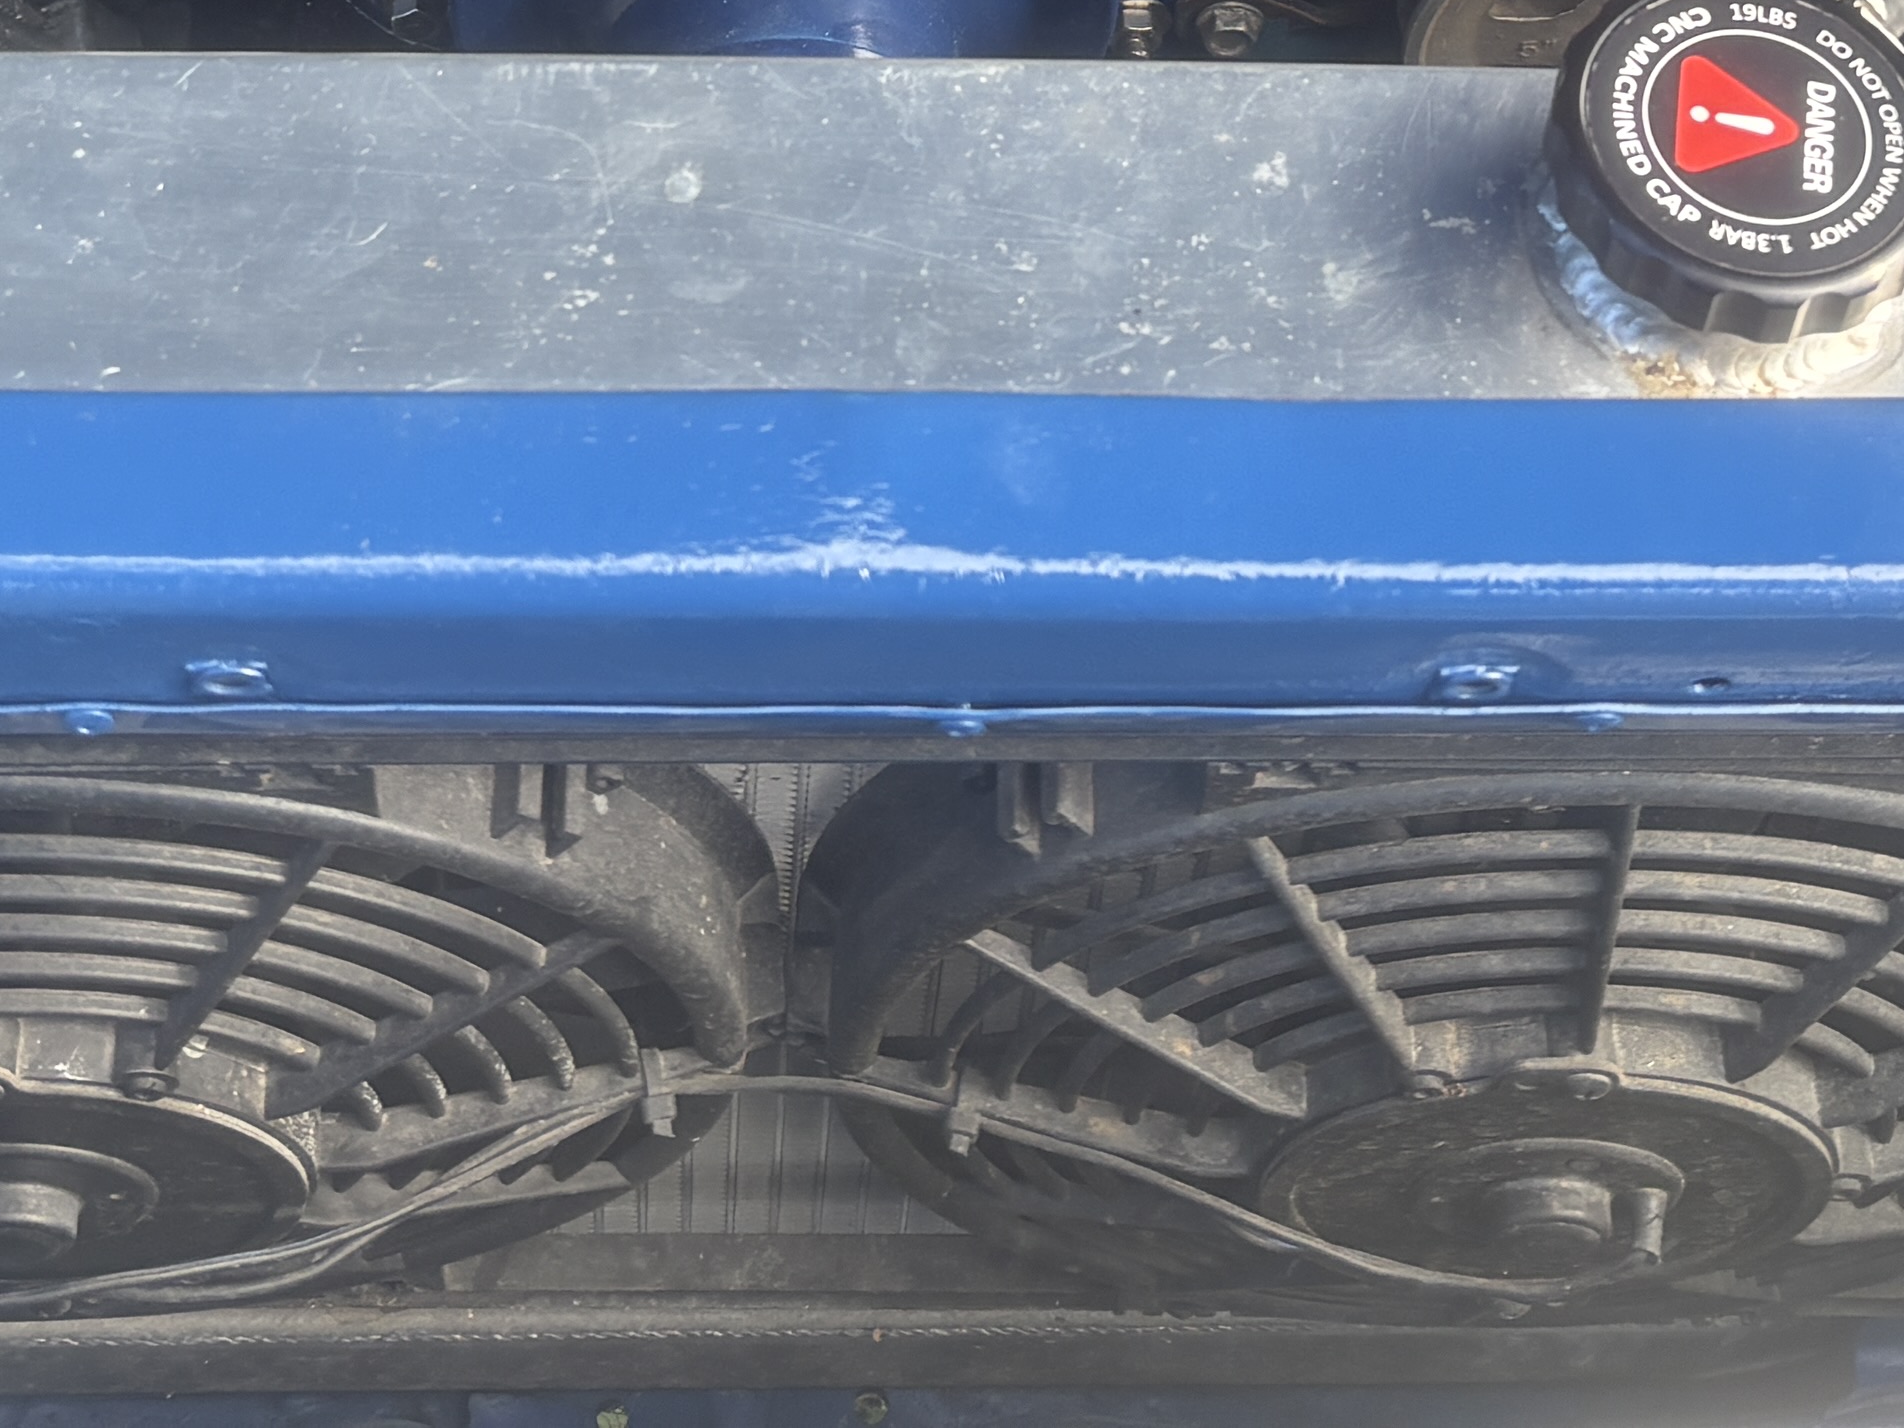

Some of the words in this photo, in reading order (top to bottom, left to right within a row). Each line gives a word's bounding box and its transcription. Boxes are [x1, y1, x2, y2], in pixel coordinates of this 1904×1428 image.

[1657, 6, 1712, 44] CNC
[1729, 3, 1797, 30] 19LBS
[1815, 29, 1853, 61] DO
[1848, 57, 1893, 101] NOT
[1611, 40, 1660, 177] MACHINED
[1802, 80, 1837, 194] DANGER
[1878, 103, 1904, 164] OPEN
[1645, 178, 1702, 224] CAP
[1852, 167, 1902, 226] WHEN
[1708, 219, 1795, 255] 1.3BAR
[1810, 218, 1858, 250] HOT
